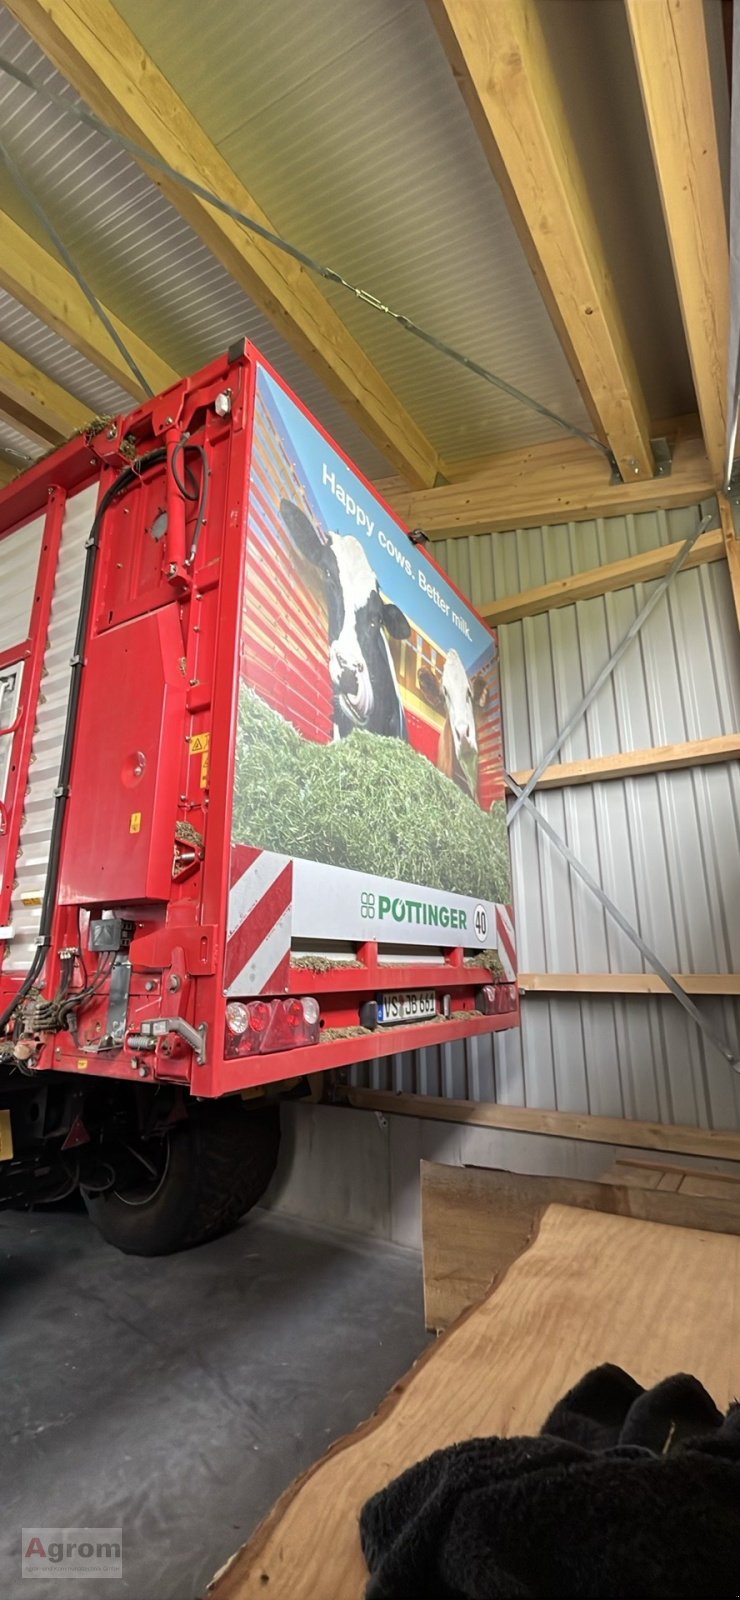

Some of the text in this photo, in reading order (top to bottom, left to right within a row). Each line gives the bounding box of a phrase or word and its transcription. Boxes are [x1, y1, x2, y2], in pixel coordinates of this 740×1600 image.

[322, 463, 473, 642] Happy cows. Better milk.
[475, 911, 487, 935] 40
[384, 993, 435, 1018] VS JB 661
